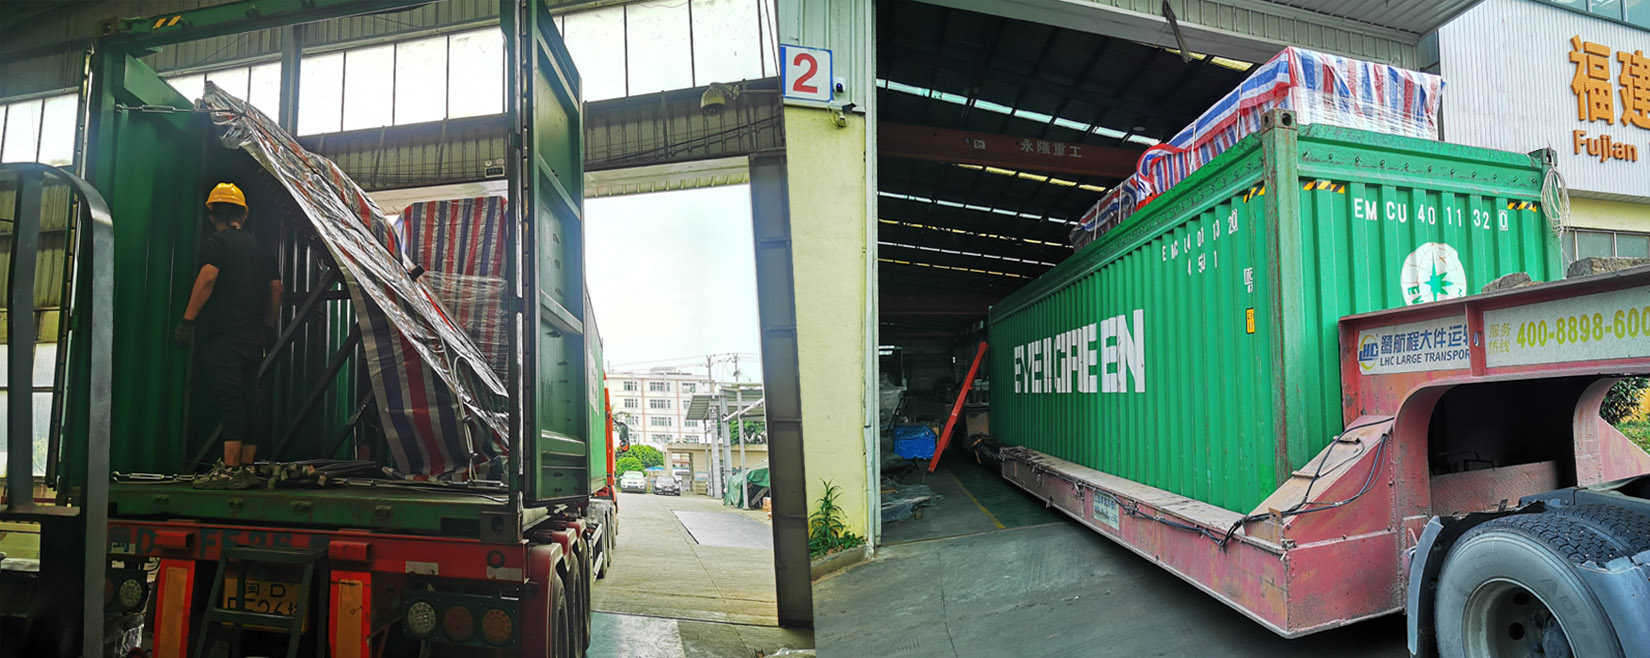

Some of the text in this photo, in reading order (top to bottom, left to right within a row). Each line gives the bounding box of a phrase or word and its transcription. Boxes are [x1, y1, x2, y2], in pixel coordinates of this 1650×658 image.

[792, 52, 818, 94] 2
[1020, 138, 1082, 158] 永隆重工
[1572, 129, 1638, 162] Fujian
[1488, 322, 1512, 338] 服务
[1014, 308, 1145, 394] EVERGREEN
[1488, 339, 1511, 354] 热线
[1380, 355, 1395, 366] LHC
[1396, 353, 1422, 365] LARGE
